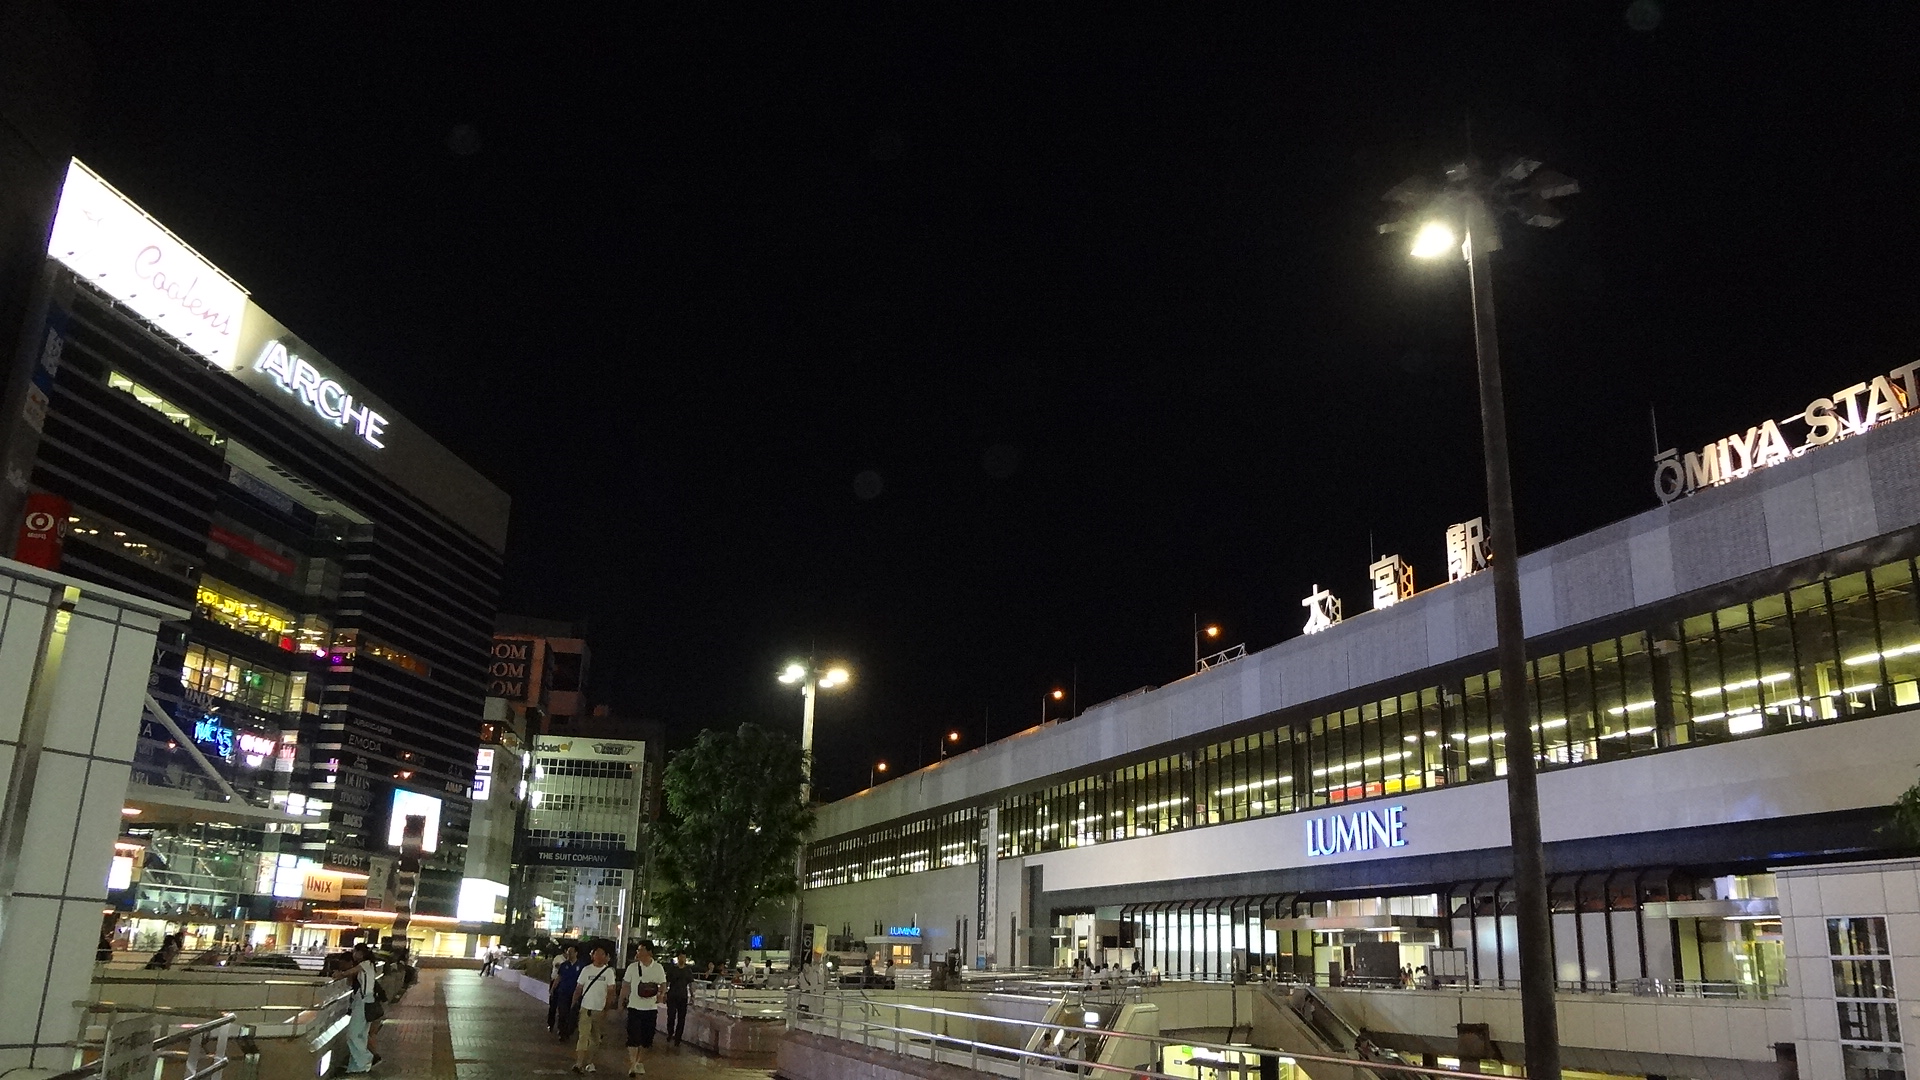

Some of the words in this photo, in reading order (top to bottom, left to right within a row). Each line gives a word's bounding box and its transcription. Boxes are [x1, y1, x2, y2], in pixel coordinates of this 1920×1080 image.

[133, 244, 231, 337] Coolens
[256, 339, 389, 450] ARCHE
[1301, 517, 1486, 634] 大宮駅
[490, 643, 528, 660] OM
[488, 661, 525, 678] OM
[348, 734, 382, 753] EMODA
[1306, 805, 1406, 857] LUMINE
[538, 852, 553, 861] THE
[555, 853, 571, 862] SUIT
[572, 854, 608, 863] COMPANY
